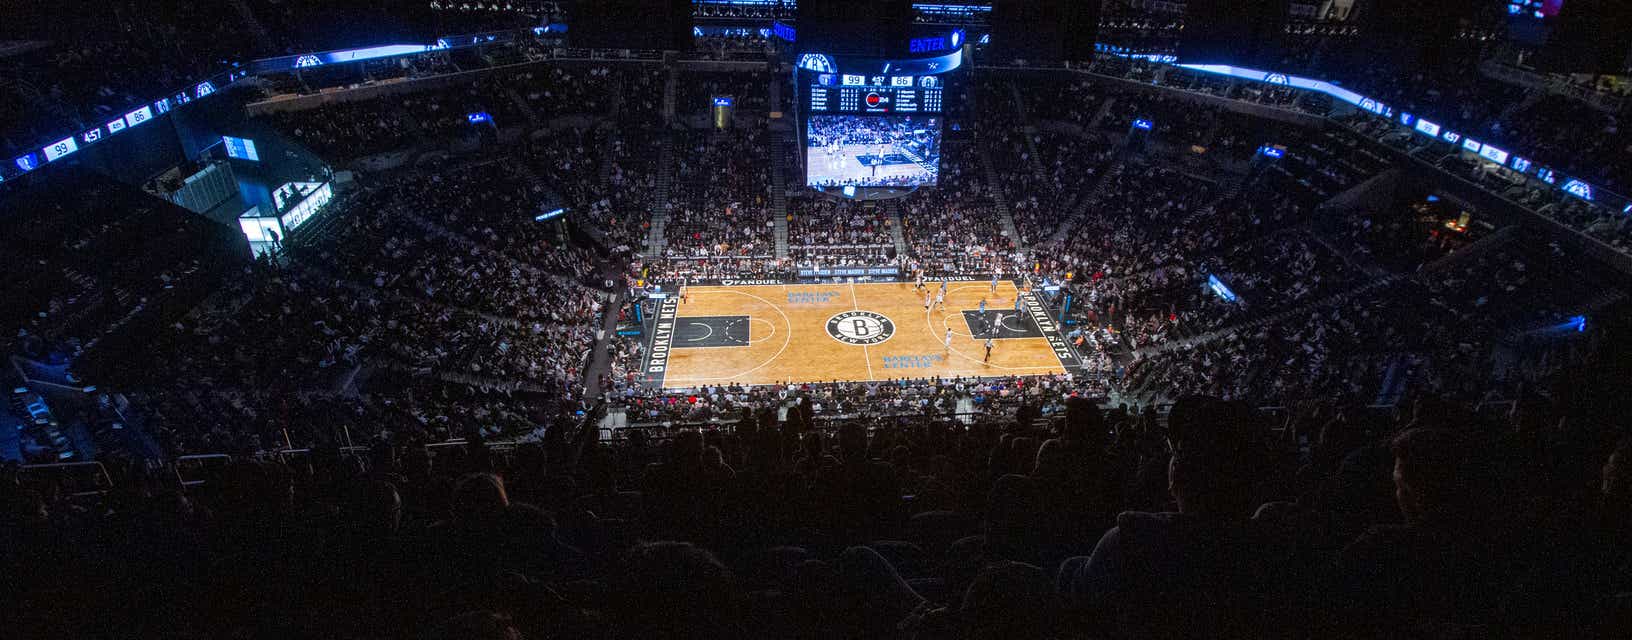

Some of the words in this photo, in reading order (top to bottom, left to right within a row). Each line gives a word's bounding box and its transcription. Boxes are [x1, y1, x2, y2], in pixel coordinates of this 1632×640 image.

[848, 76, 860, 85] 99
[896, 77, 908, 85] 86
[134, 110, 145, 122] 86
[55, 142, 68, 156] 99
[660, 296, 677, 319] NETS
[852, 319, 870, 336] B
[648, 323, 673, 373] BROOKLYN
[883, 361, 932, 369] CENTER
